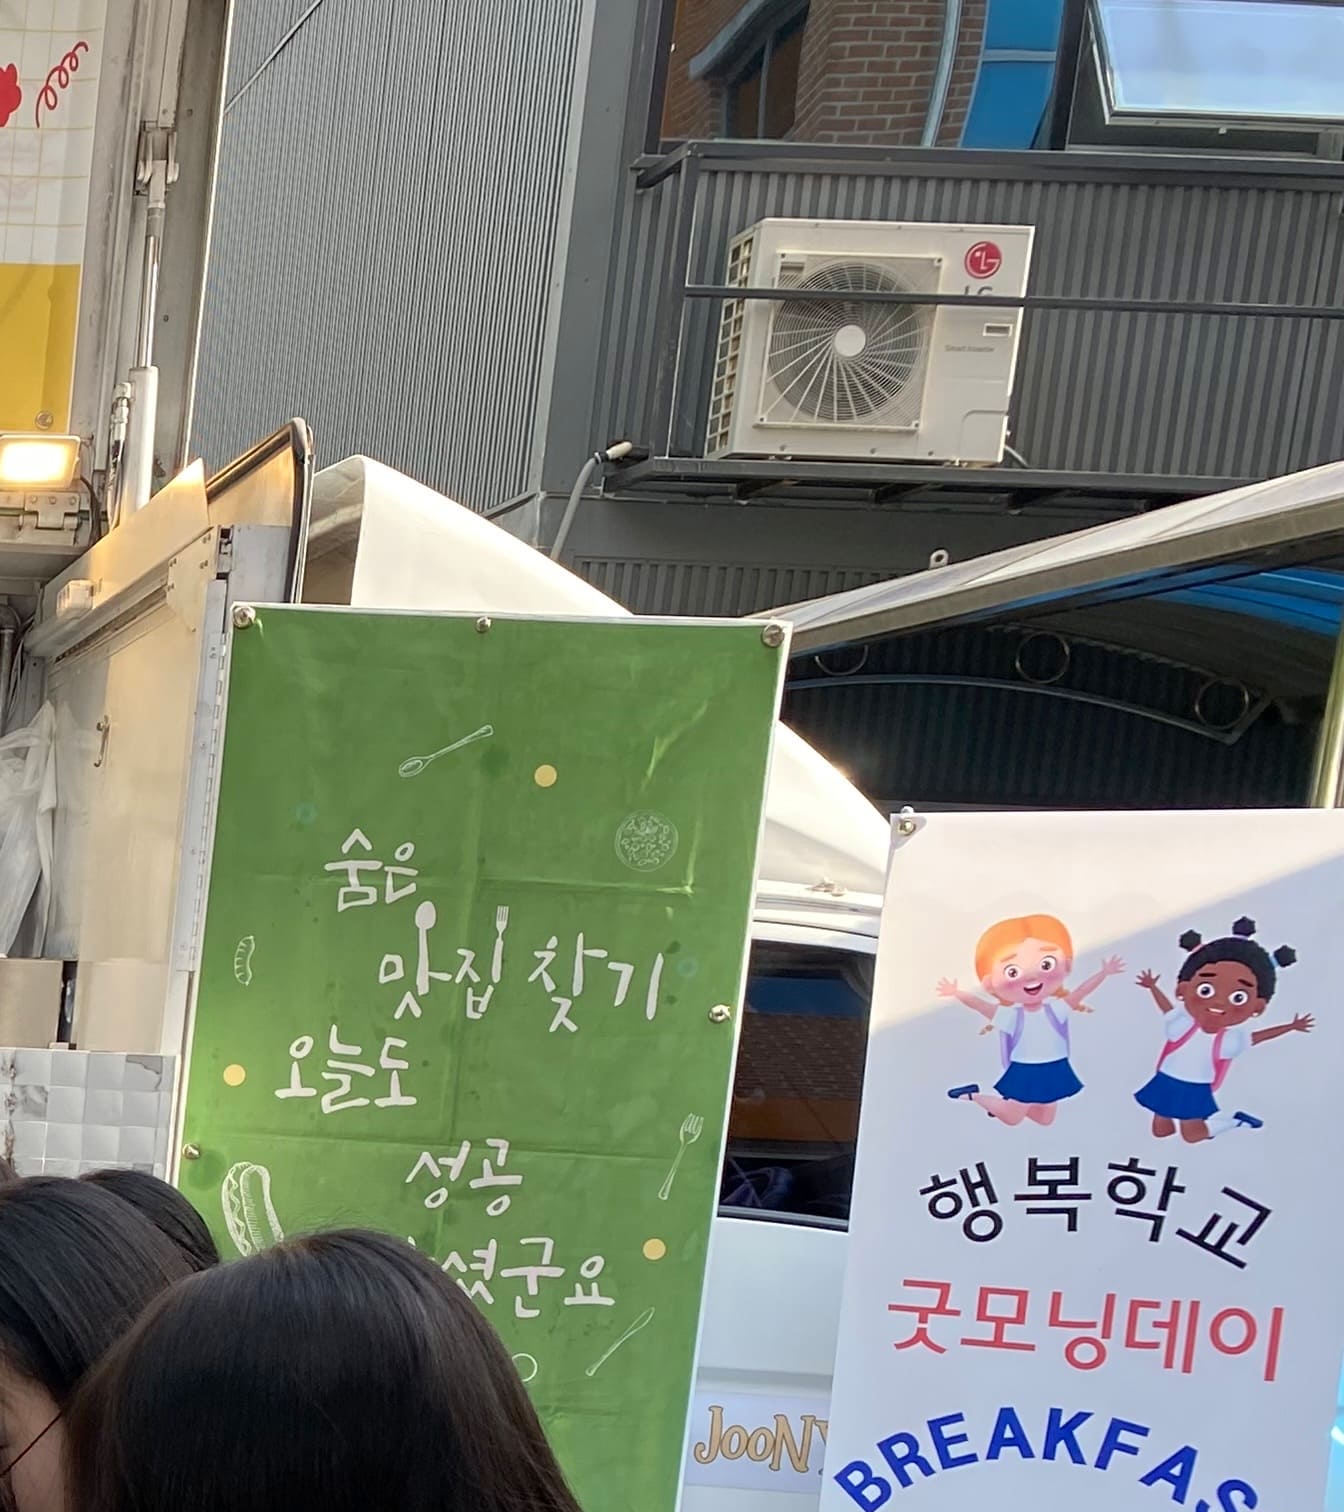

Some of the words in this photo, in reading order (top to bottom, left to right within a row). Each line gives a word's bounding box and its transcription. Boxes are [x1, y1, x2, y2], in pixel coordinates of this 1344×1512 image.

[324, 828, 419, 912] 숨은
[378, 899, 510, 1020] 맛집
[528, 932, 664, 1033] 찾기
[275, 1024, 417, 1114] 오늘도
[405, 1138, 523, 1217] 성공
[918, 1155, 1273, 1270] 행복학교
[408, 1235, 616, 1319] 셨군요
[887, 1278, 1284, 1382] 굿모닝데이
